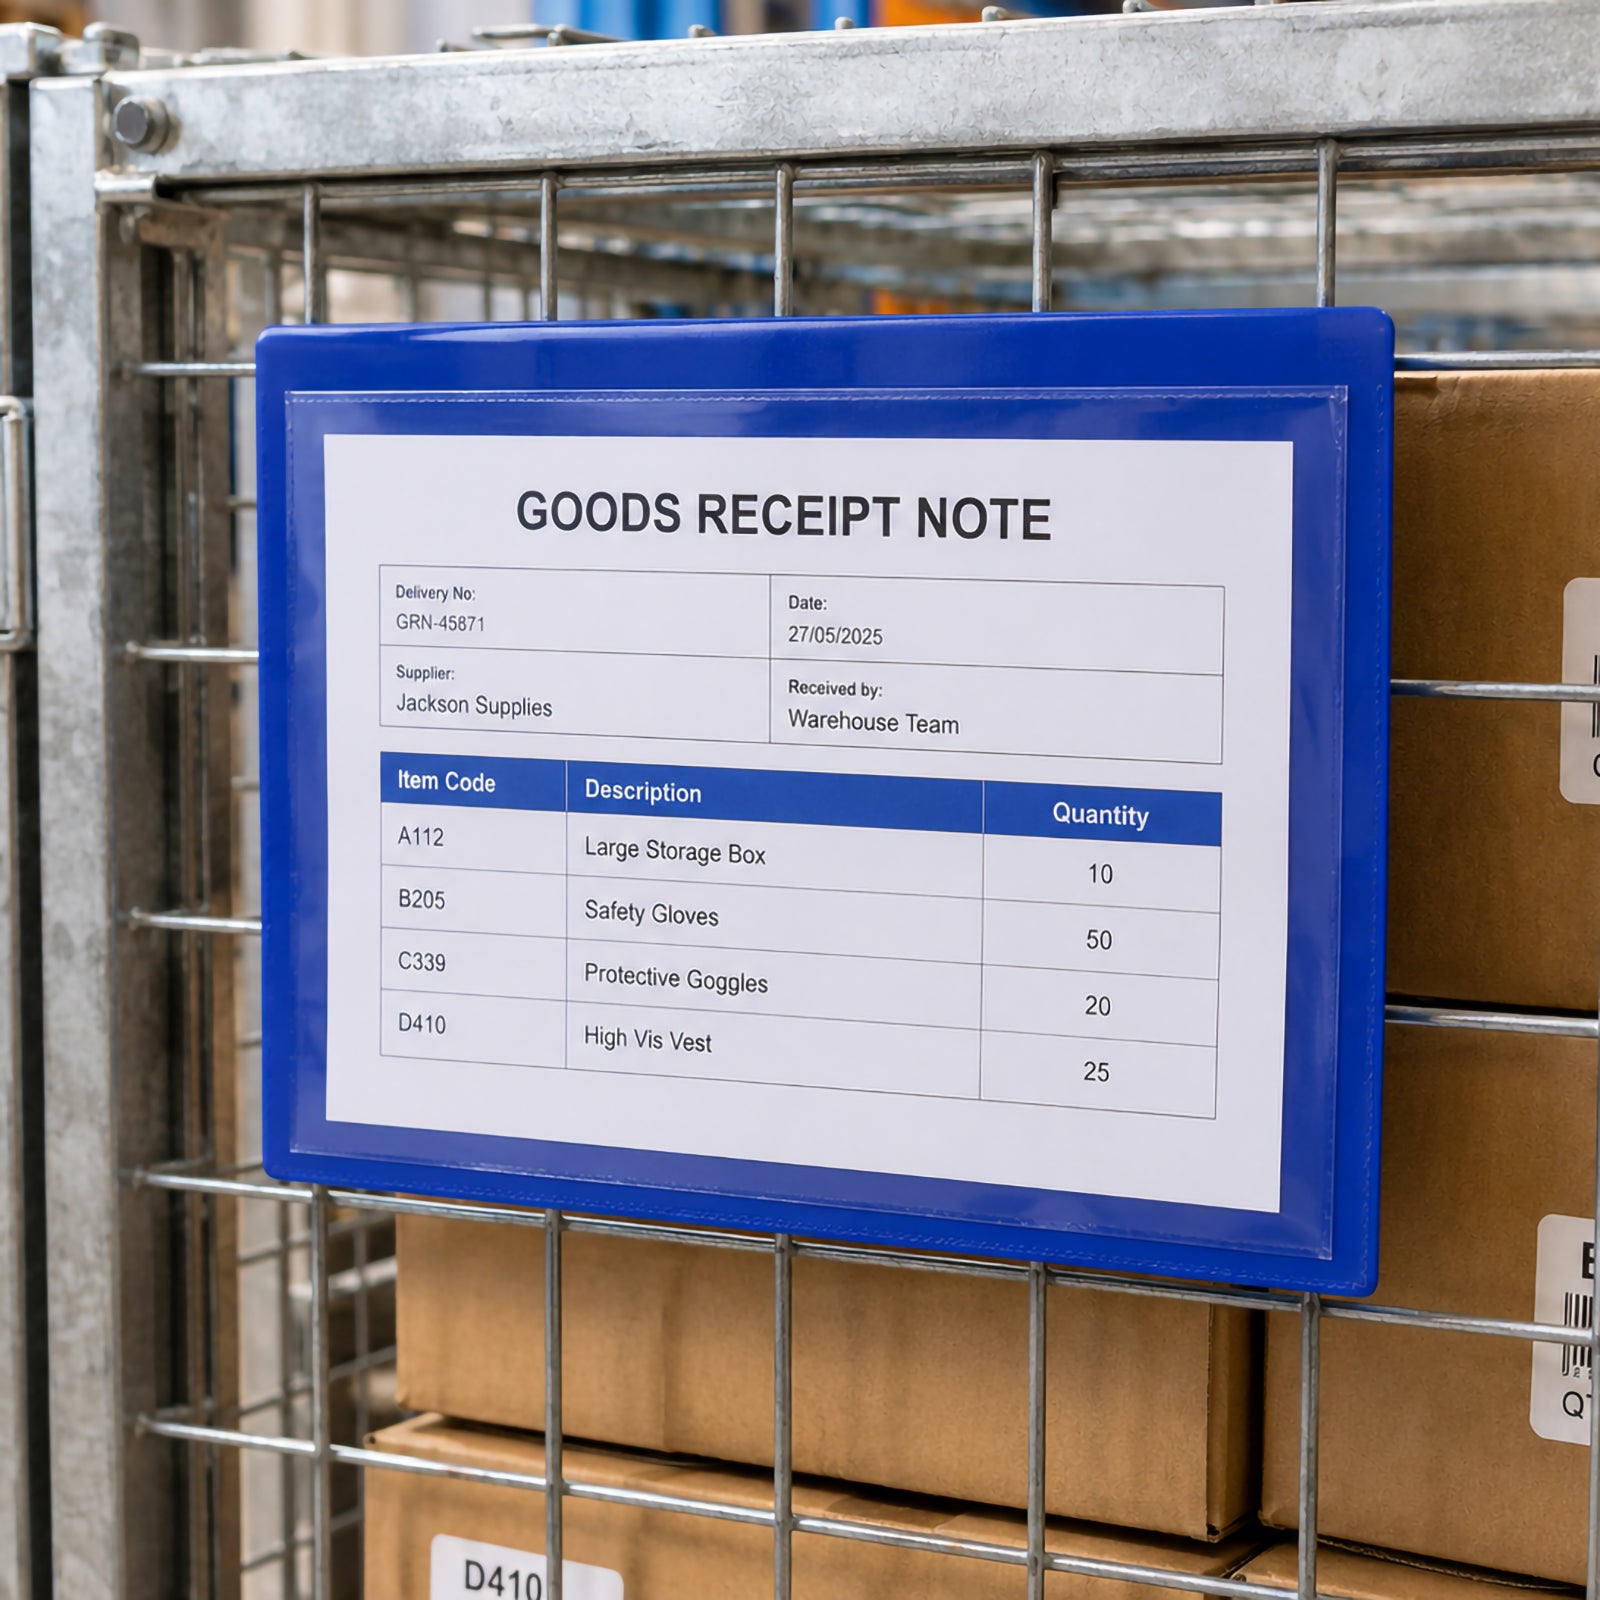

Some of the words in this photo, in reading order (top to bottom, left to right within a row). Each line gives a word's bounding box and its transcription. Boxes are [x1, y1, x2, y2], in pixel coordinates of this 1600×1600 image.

[517, 491, 680, 533] GOODS
[699, 494, 900, 537] RECEIPT
[918, 497, 1051, 540] NOTE
[396, 585, 448, 603] Delivery
[453, 587, 475, 600] No:
[789, 595, 826, 610] Date:
[397, 613, 483, 631] GRN-45871
[789, 626, 883, 645] 27/05/2025
[397, 665, 454, 682] Supplier:
[789, 679, 856, 696] Received
[861, 682, 882, 700] by:
[397, 693, 468, 713] Jackson
[476, 695, 552, 719] Supplies
[789, 709, 898, 732] Warehouse
[906, 714, 959, 734] Team
[399, 769, 438, 789] Item
[446, 771, 495, 792] Code
[586, 779, 701, 805] Description
[1053, 802, 1149, 831] Quantity
[398, 826, 443, 846] A112
[586, 836, 639, 862] Large
[647, 840, 721, 866] Storage
[729, 844, 765, 864] Box
[1090, 864, 1112, 884] 10
[400, 889, 445, 909] B205
[586, 899, 645, 926] Safety
[652, 904, 718, 926] Gloves
[1087, 930, 1112, 950] 50
[399, 951, 445, 972] C339
[586, 963, 680, 987] Protective
[687, 969, 768, 996] Goggles
[1086, 995, 1110, 1016] 20
[399, 1013, 445, 1034] D410
[585, 1026, 626, 1051] High
[634, 1029, 662, 1049] Vis
[670, 1032, 712, 1053] Vest
[1084, 1061, 1109, 1082] 25
[465, 1559, 542, 1600] D410
